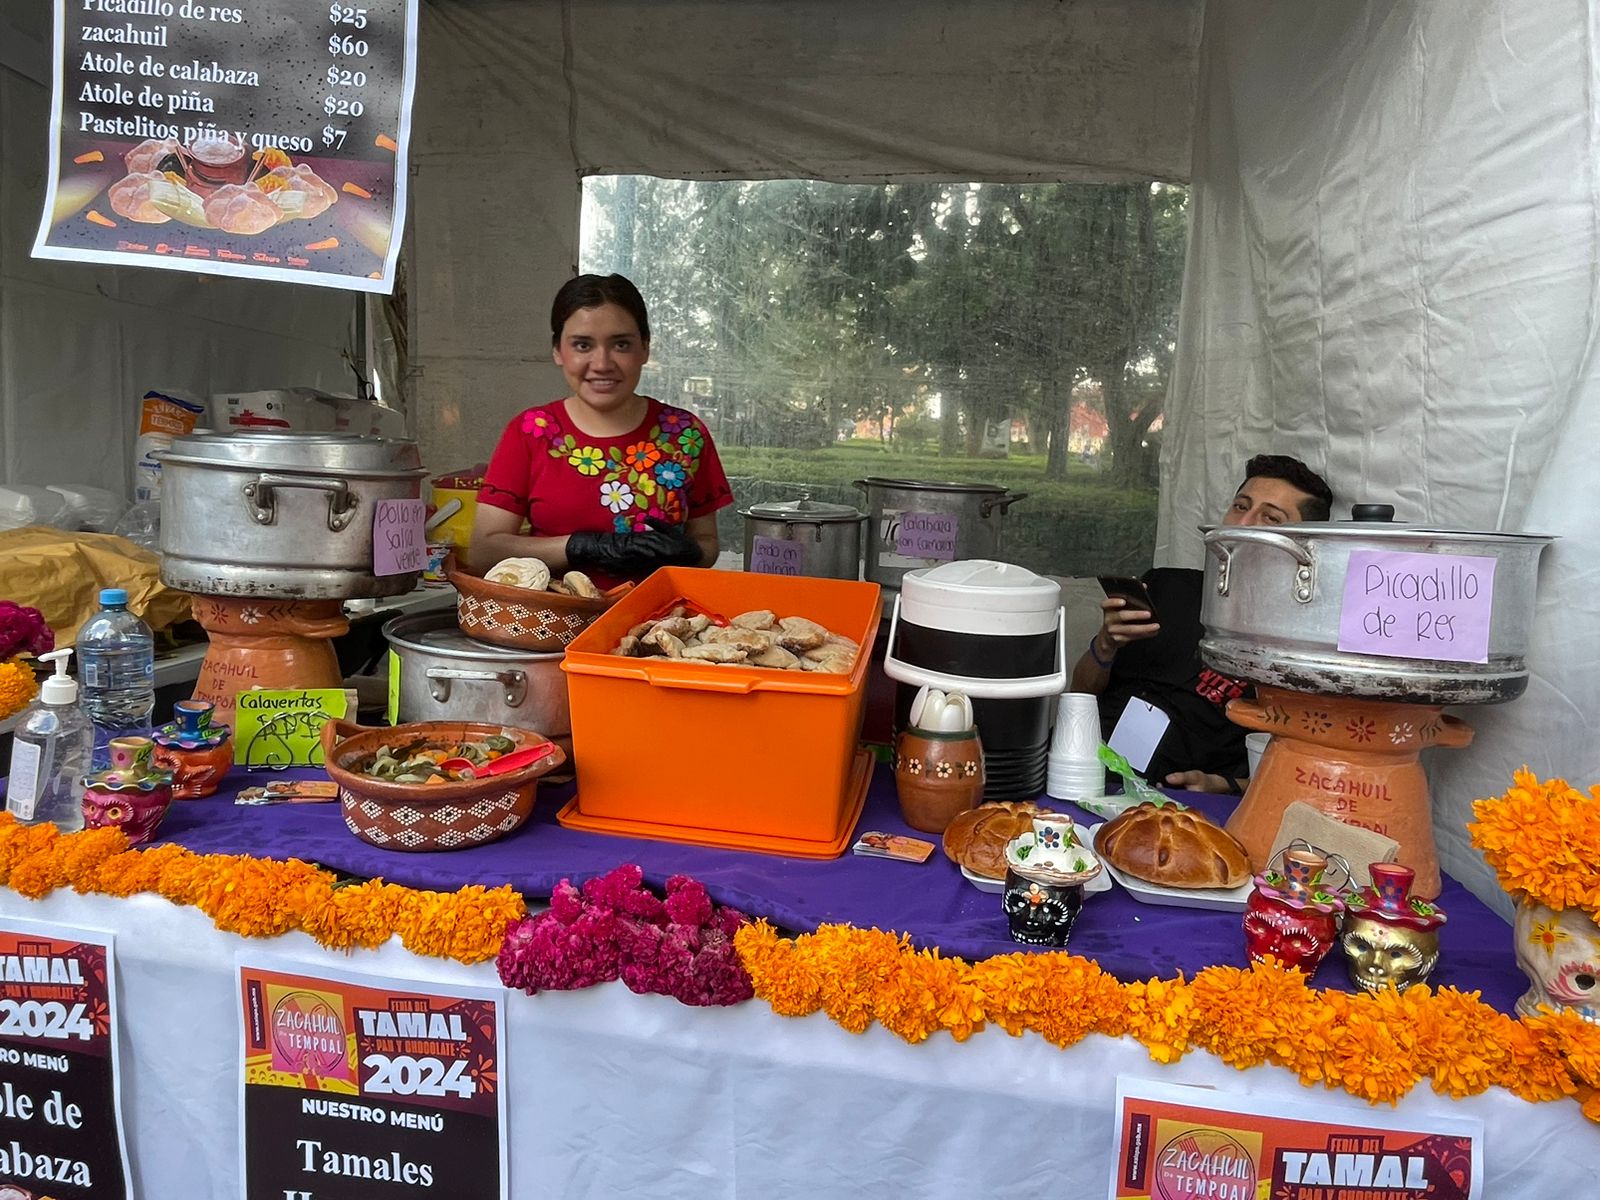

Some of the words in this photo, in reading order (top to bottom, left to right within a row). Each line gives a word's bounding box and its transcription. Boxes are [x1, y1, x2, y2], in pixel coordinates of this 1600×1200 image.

[179, 0, 205, 20] de
[208, 6, 243, 24] res
[329, 1, 367, 29] $25
[81, 22, 168, 47] zacahuil
[328, 32, 369, 57] $60
[80, 50, 135, 75] Atole
[139, 55, 165, 78] de
[169, 59, 260, 87] calabaza
[326, 64, 367, 87] $20
[79, 81, 134, 106] Atole
[138, 86, 163, 108] de
[167, 90, 215, 115] piña
[324, 94, 364, 117] $20
[79, 111, 179, 140] Pastelitos
[183, 121, 229, 147] piña
[234, 131, 248, 151] y
[251, 131, 314, 153] queso
[322, 123, 348, 151] $7
[379, 502, 409, 528] Pollo
[1365, 564, 1479, 602] Picadillo
[1363, 606, 1396, 638] de
[1417, 611, 1456, 642] Res
[202, 659, 260, 679] ZACAHUIL
[212, 679, 225, 690] DE
[240, 692, 323, 709] Calaveritas
[1295, 766, 1393, 802] ZACAHUIL
[1336, 797, 1358, 813] DE
[0, 999, 94, 1041] 2024
[276, 1008, 341, 1036] ZACAHUIL
[358, 1009, 468, 1041] TAMAL
[288, 1033, 343, 1055] TEMPOAL
[375, 1038, 395, 1053] PAN
[395, 1040, 404, 1054] Y
[405, 1040, 457, 1057] CHOCOLATE
[23, 1051, 69, 1073] MENÚ
[362, 1054, 477, 1099] 2024
[43, 1090, 83, 1129] de
[302, 1098, 387, 1125] NUESTRO
[390, 1110, 445, 1133] MENÚ
[0, 1141, 93, 1188] abaza
[296, 1139, 435, 1188] Tamales
[1163, 1148, 1250, 1181] ZACAHUIL
[1282, 1151, 1429, 1190] TAMAL
[1176, 1175, 1248, 1200] TEMPOAL
